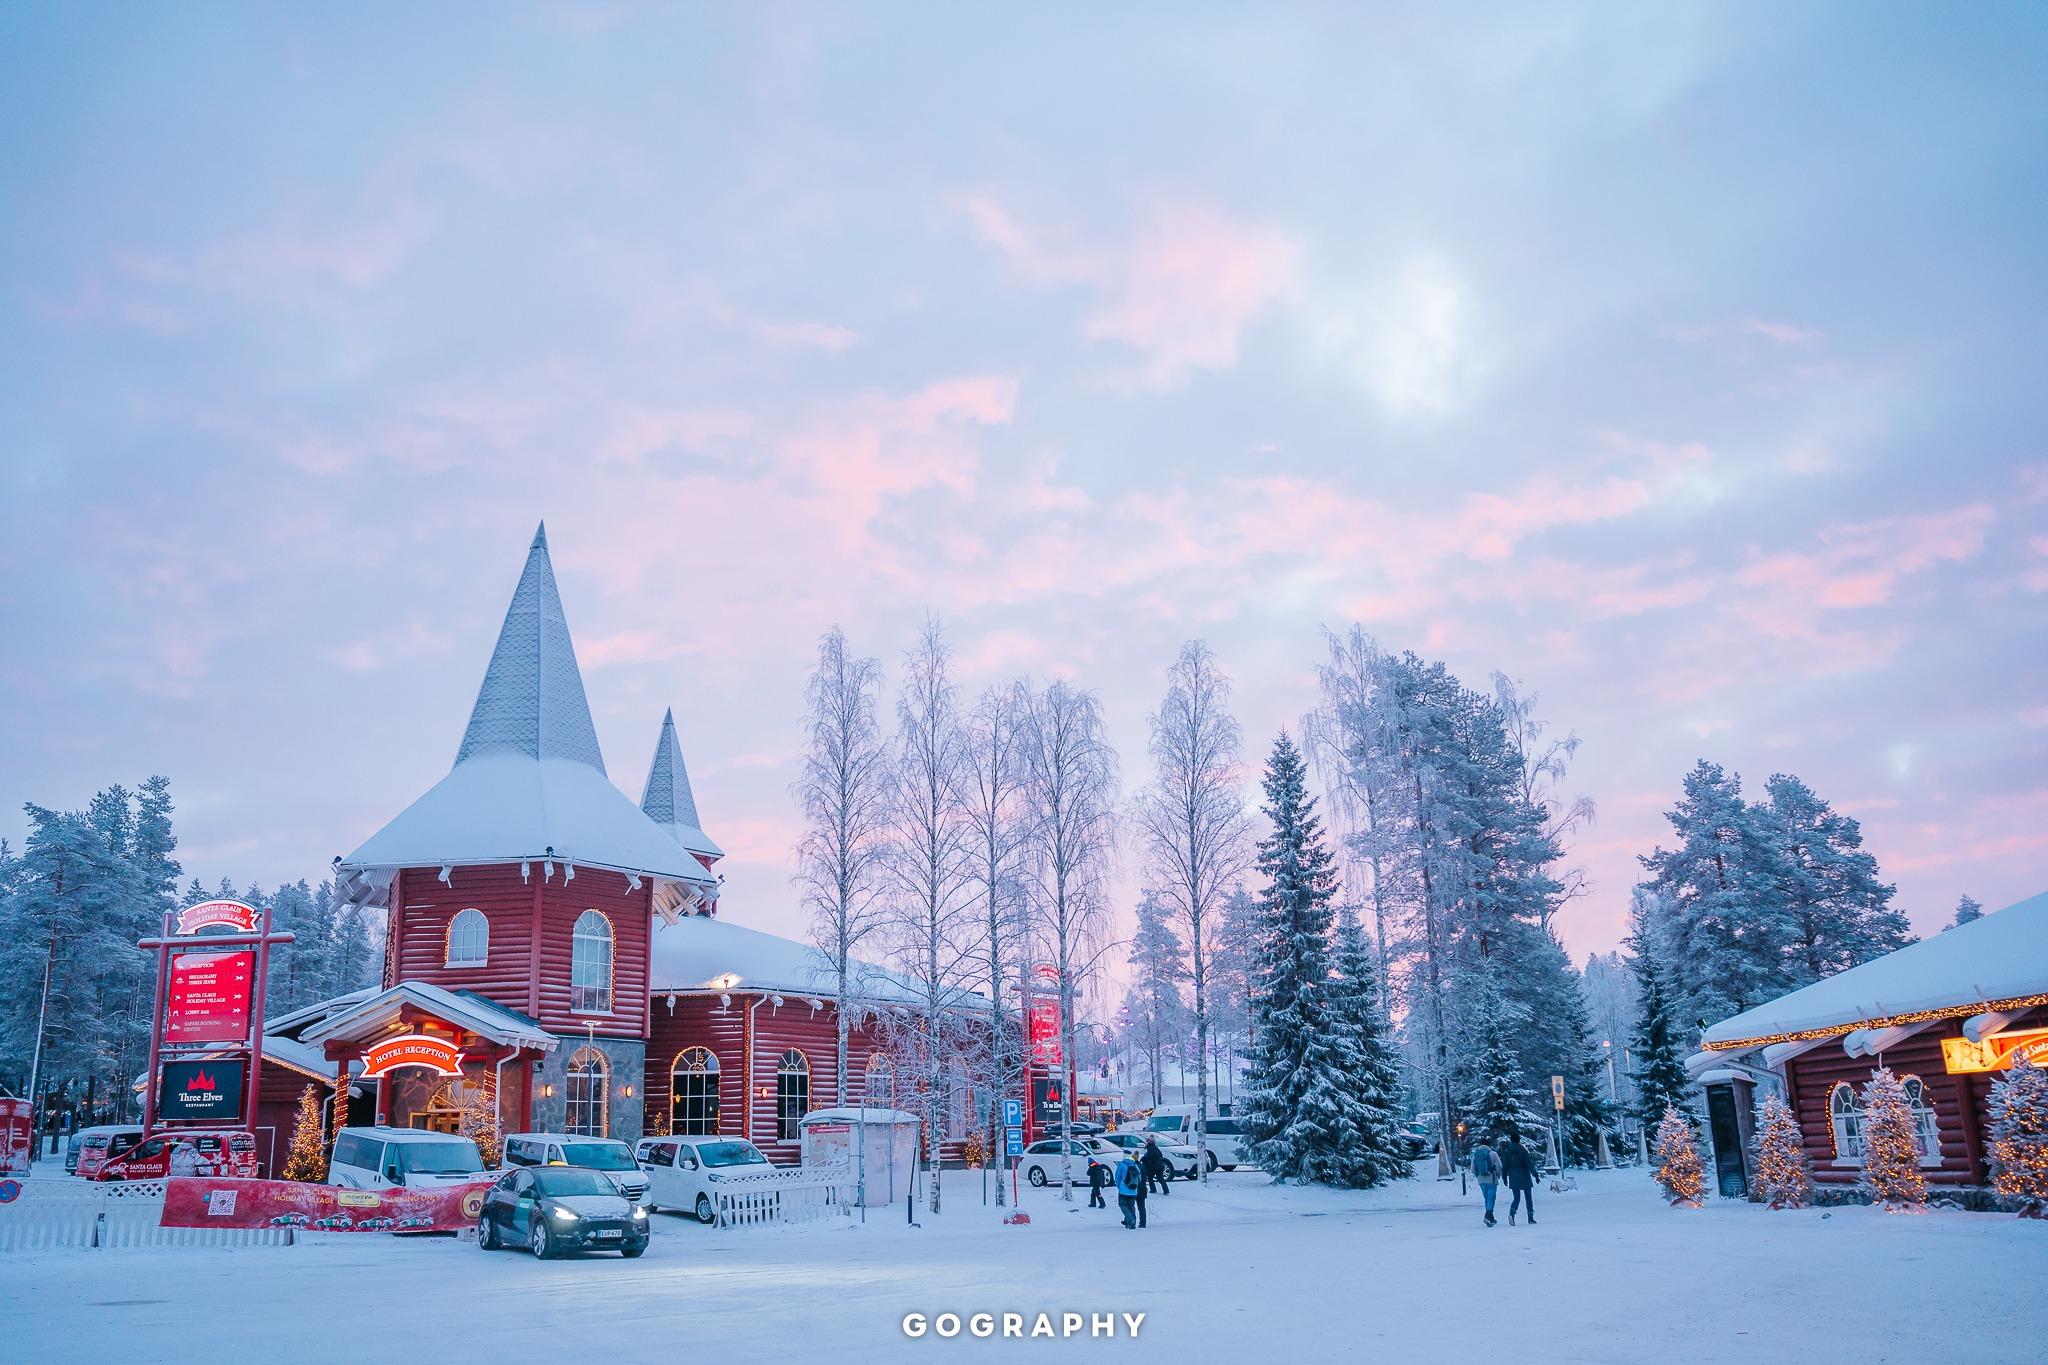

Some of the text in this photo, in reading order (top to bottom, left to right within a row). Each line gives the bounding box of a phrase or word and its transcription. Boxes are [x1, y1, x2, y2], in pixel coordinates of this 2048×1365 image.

[220, 905, 242, 913] CLAUS
[220, 913, 248, 925] VILLAGE
[375, 1046, 451, 1064] HOTEL RECEPTION
[178, 1092, 223, 1102] Three Elves
[1007, 1102, 1018, 1124] P
